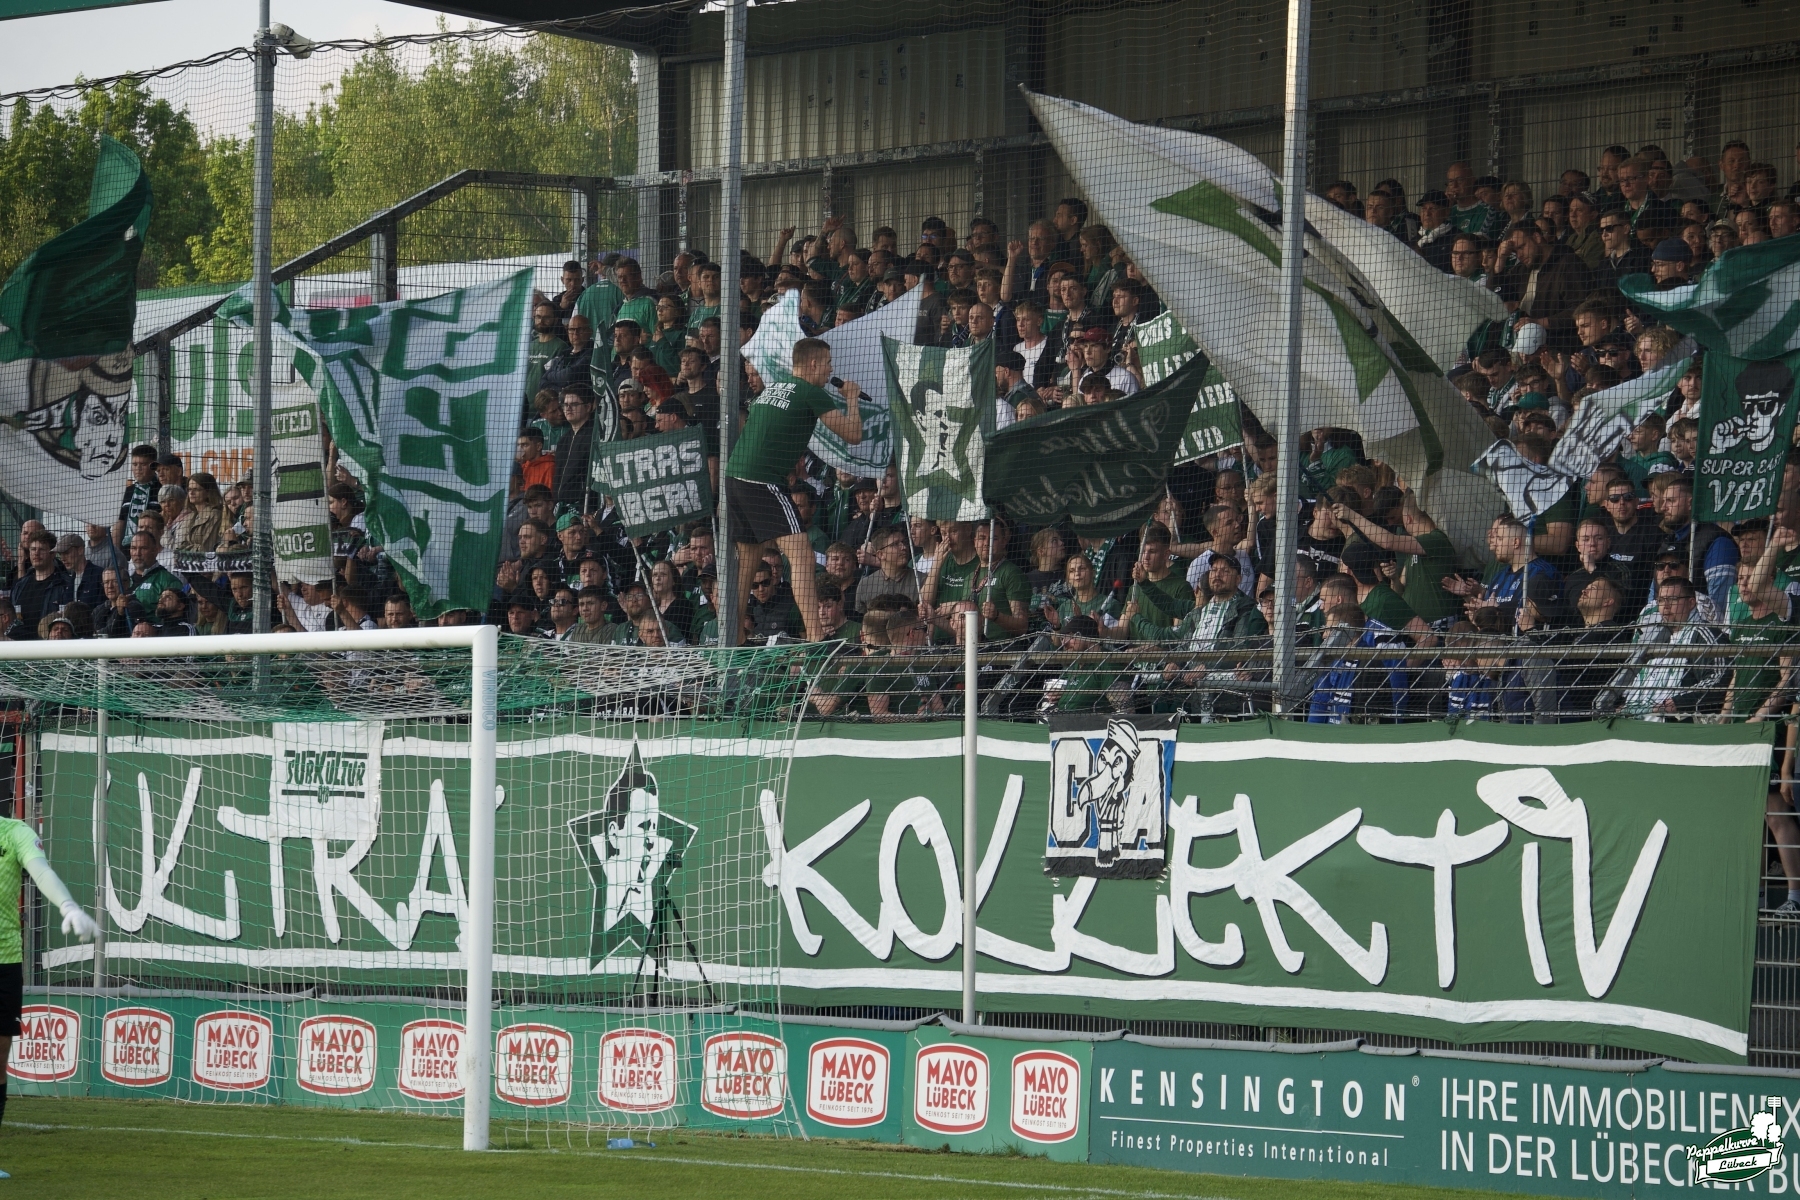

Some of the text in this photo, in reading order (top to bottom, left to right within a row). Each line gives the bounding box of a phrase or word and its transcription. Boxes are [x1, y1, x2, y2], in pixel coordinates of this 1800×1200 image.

[1701, 458, 1754, 476] SUPER
[1708, 471, 1776, 516] VfB!
[482, 669, 497, 731] VINDICO
[285, 750, 366, 787] SUBKULTUR
[114, 1020, 162, 1045] MAYO
[208, 1023, 260, 1049] MAYO
[311, 1028, 364, 1053] MAYO
[412, 1032, 460, 1058] MAYO
[19, 1042, 66, 1061] LÜBECK
[113, 1045, 160, 1066] LÜBECK
[206, 1049, 258, 1070] LÜBECK
[509, 1037, 560, 1063] MAYO
[613, 1042, 664, 1068] MAYO
[717, 1046, 774, 1074] MAYO
[309, 1053, 363, 1075] LÜBECK
[411, 1058, 458, 1079] LÜBECK
[508, 1063, 558, 1085] LÜBECK
[821, 1052, 877, 1081] MAYO
[926, 1057, 978, 1088] MAYO
[612, 1068, 663, 1090] LÜBECK
[715, 1073, 773, 1096] LÜBECK
[1023, 1064, 1069, 1095] MAYO
[820, 1080, 874, 1104] LÜBECK
[926, 1087, 976, 1111] LÜBECK
[1442, 1077, 1518, 1123] IHRE
[819, 1104, 846, 1112] FEINKOST
[925, 1110, 951, 1119] FEINKOST
[1023, 1094, 1067, 1119] LÜBECK
[1022, 1118, 1046, 1127] FEINKOST
[1111, 1131, 1388, 1167] Finest Properties International
[1441, 1130, 1474, 1173] IN
[1488, 1133, 1558, 1180] DER
[1571, 1131, 1755, 1192] LÜBEC
